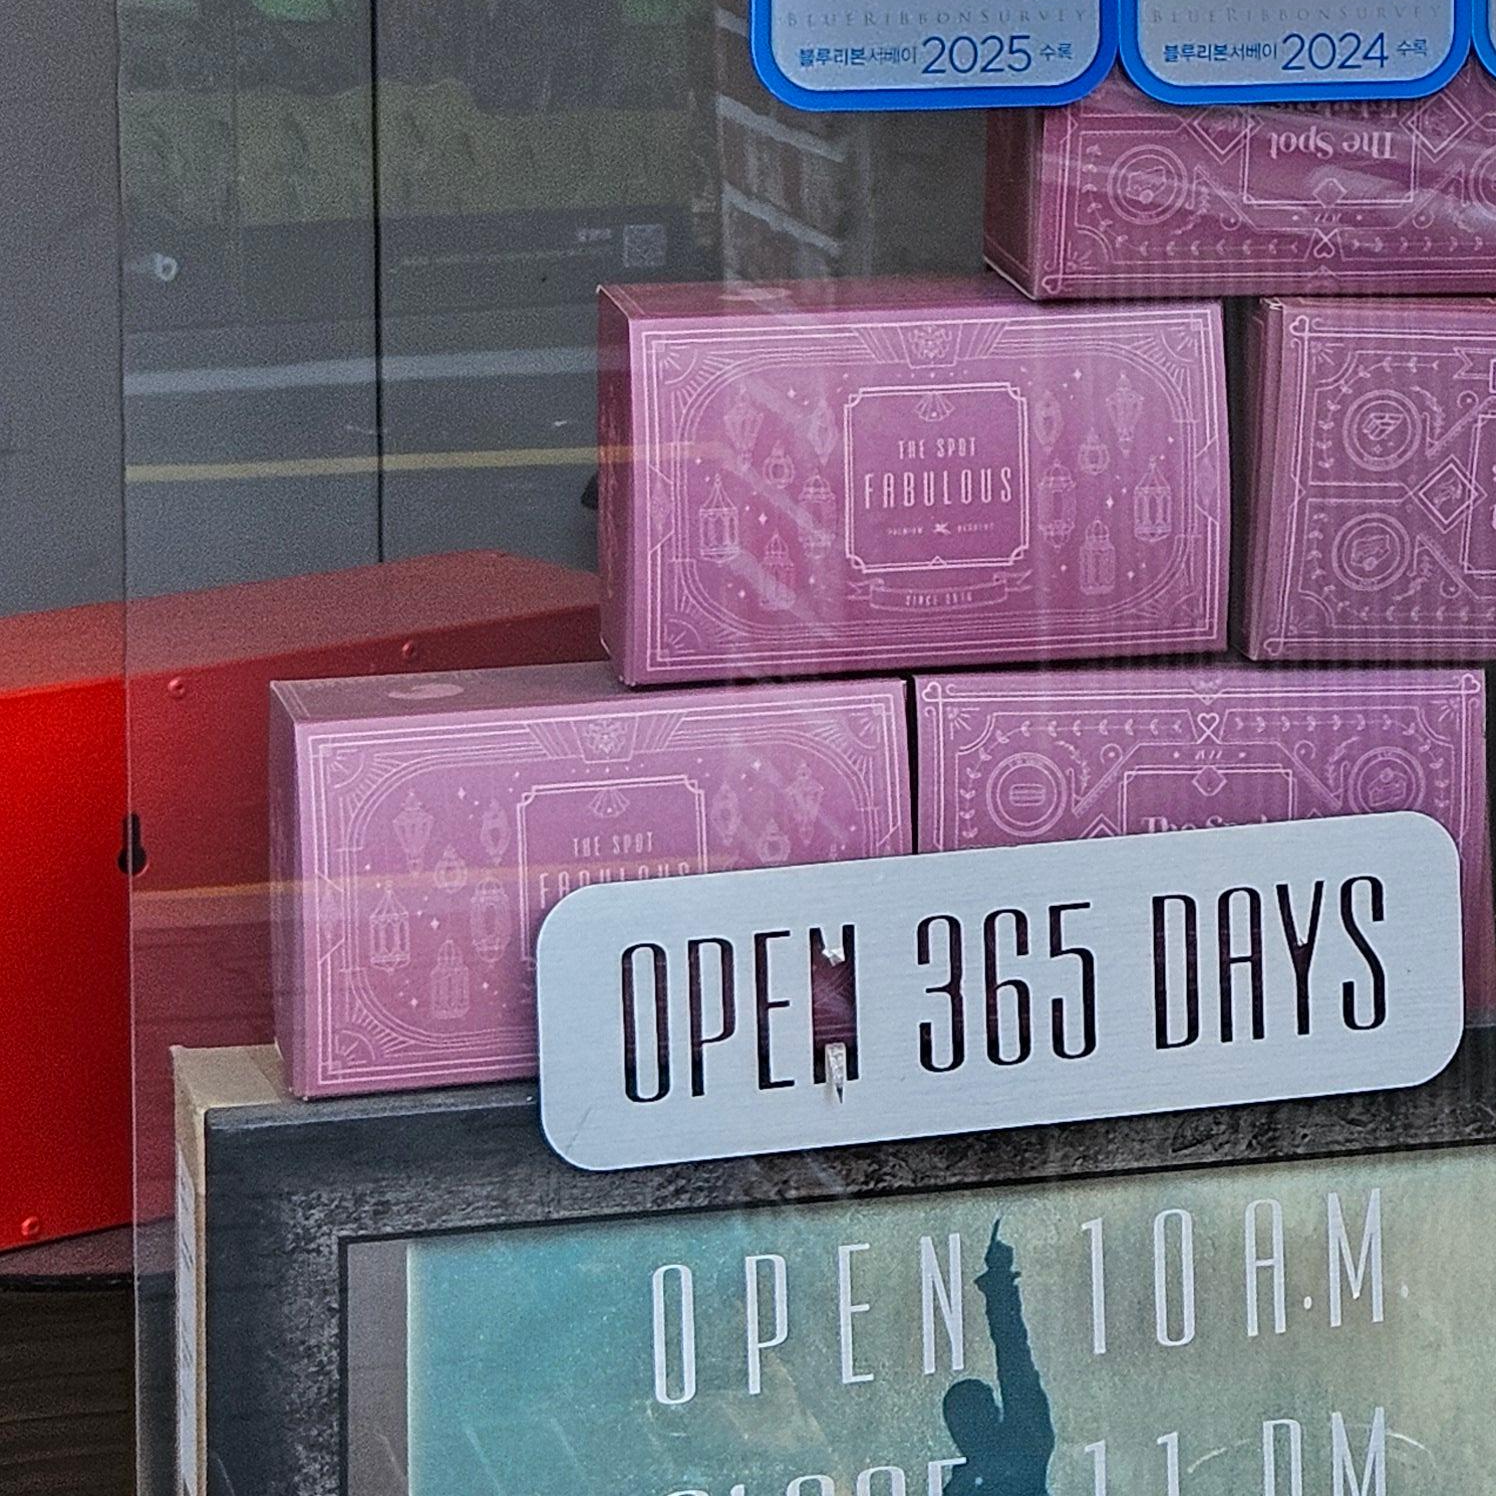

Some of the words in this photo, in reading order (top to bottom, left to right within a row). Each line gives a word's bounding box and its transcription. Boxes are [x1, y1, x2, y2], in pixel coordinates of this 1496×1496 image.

[799, 45, 918, 67] 블루리본서베이
[920, 34, 1033, 74] 2025
[1039, 42, 1074, 62] 수록
[1163, 42, 1278, 63] 블루리본서베이
[1280, 31, 1389, 71] 2024
[1397, 38, 1428, 57] 수록
[1267, 125, 1336, 161] Spot
[1341, 130, 1398, 160] The
[898, 439, 926, 461] THE
[935, 436, 977, 459] SPOT
[863, 465, 1013, 510] FABULOUS
[572, 835, 601, 858] THE
[612, 830, 654, 855] SPOT
[620, 923, 860, 1104] OPEN
[915, 901, 1096, 1074] 365
[1152, 874, 1386, 1052] DAYS
[651, 1231, 969, 1405] OPEN
